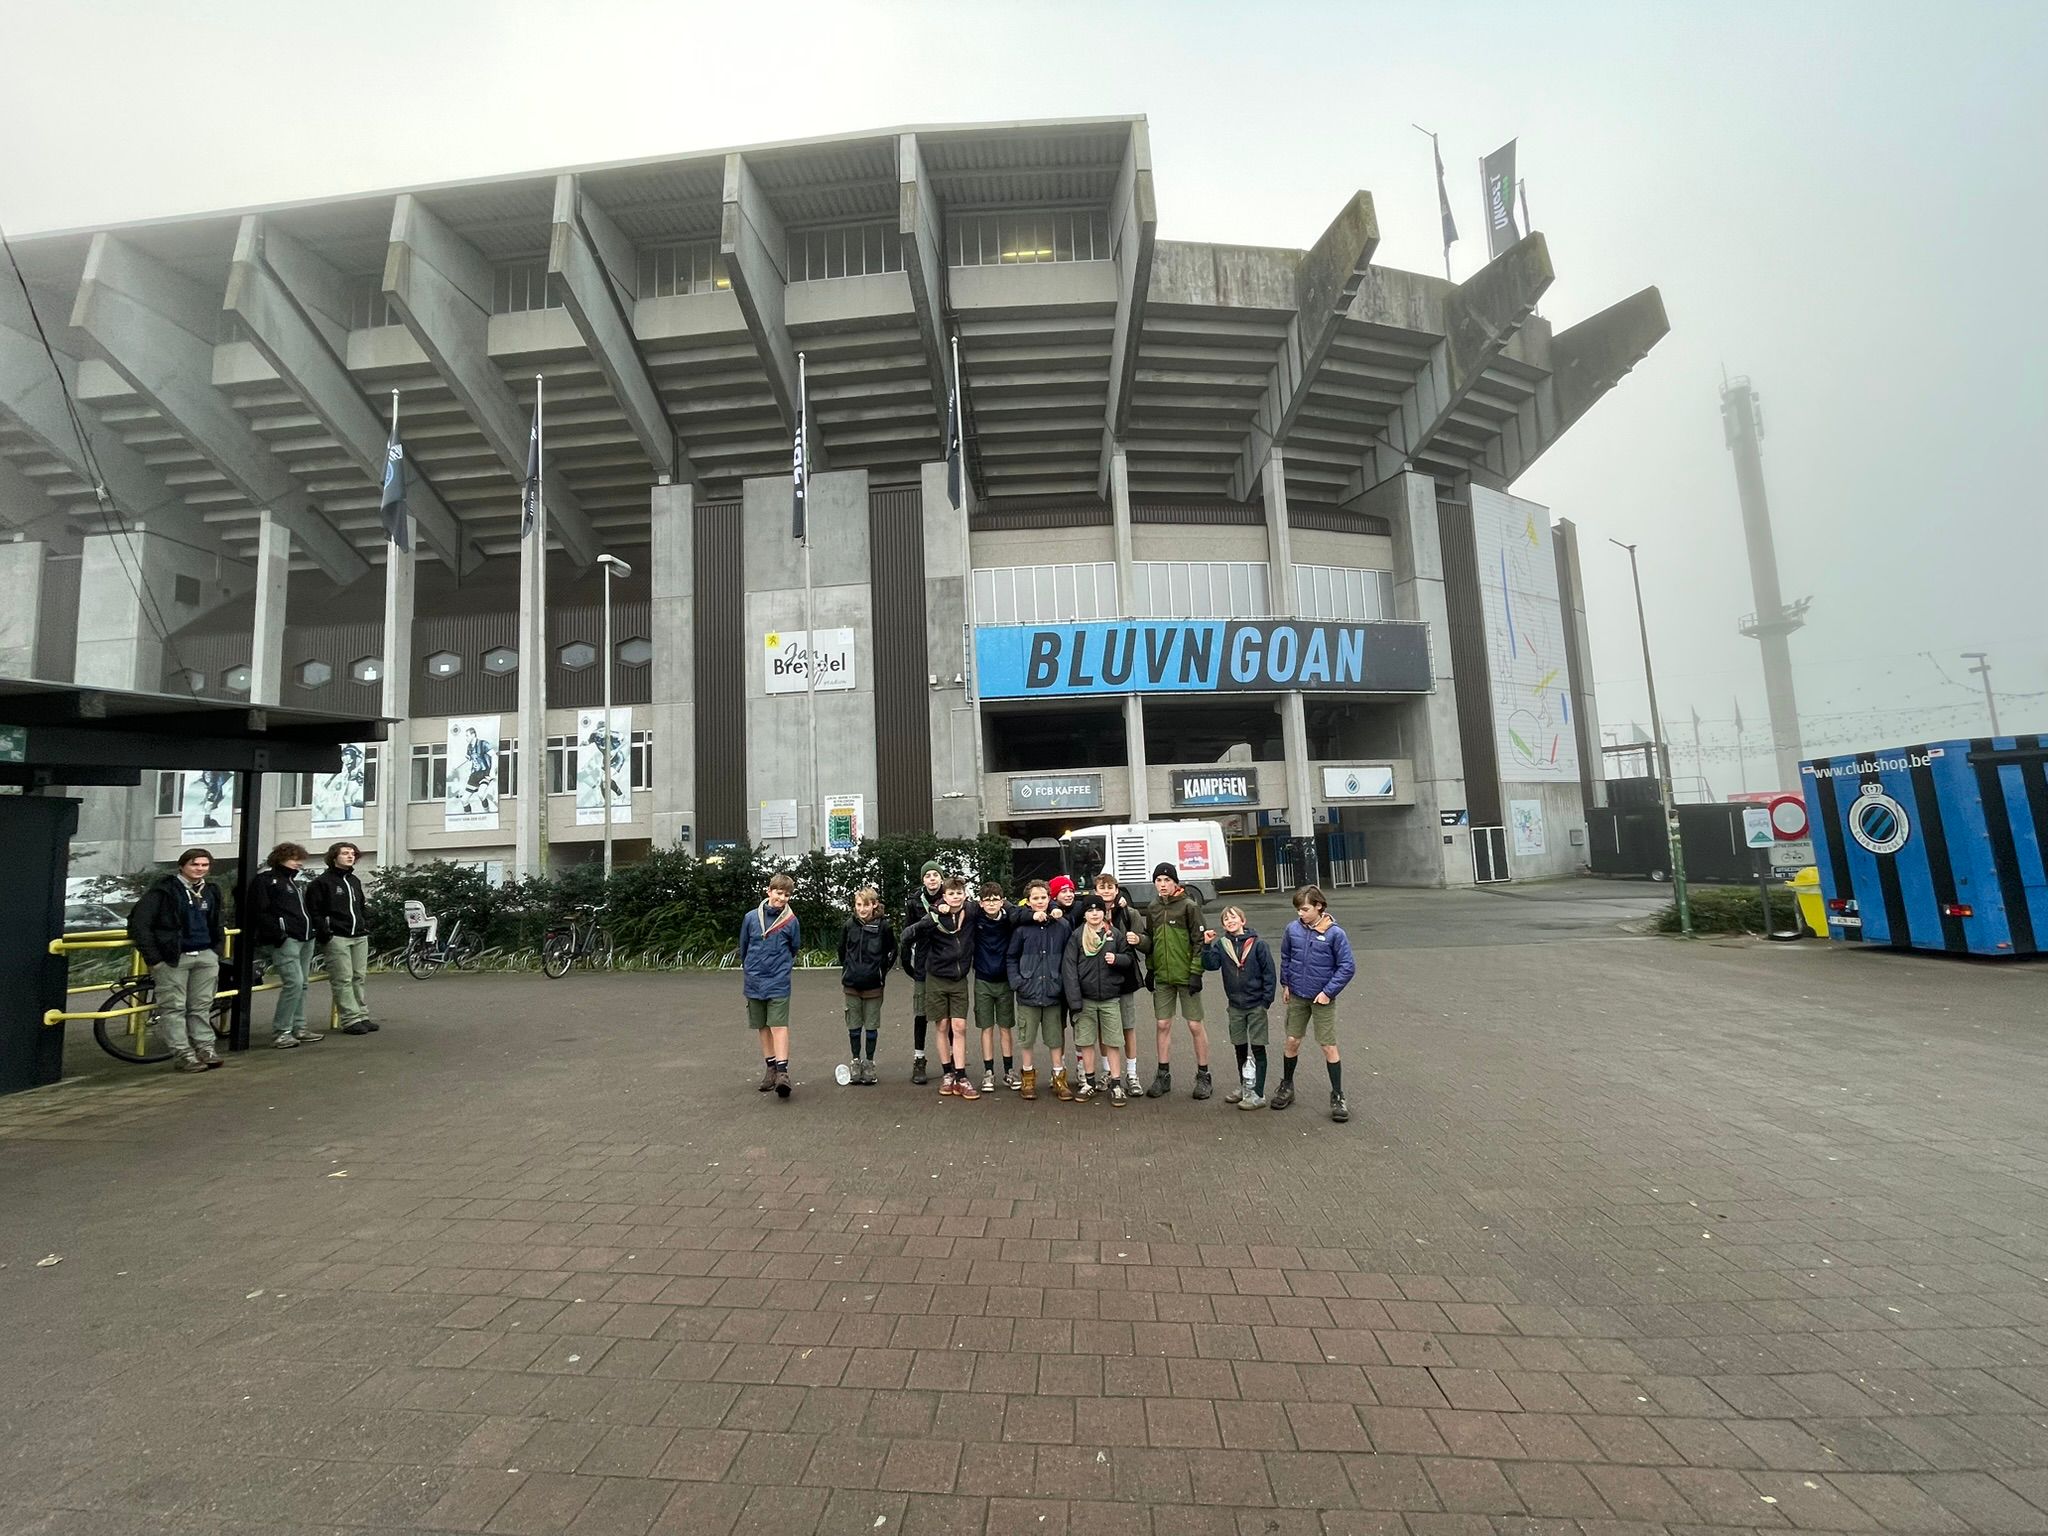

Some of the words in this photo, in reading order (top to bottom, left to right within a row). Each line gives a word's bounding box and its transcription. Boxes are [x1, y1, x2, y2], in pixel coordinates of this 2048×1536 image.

[784, 642, 819, 666] Jan
[1026, 628, 1213, 690] BLUVN
[1230, 626, 1365, 683] GOAN
[1813, 754, 1931, 779] www.clubshop.be
[1035, 787, 1053, 796] FCB
[1055, 785, 1091, 795] KAFFEE
